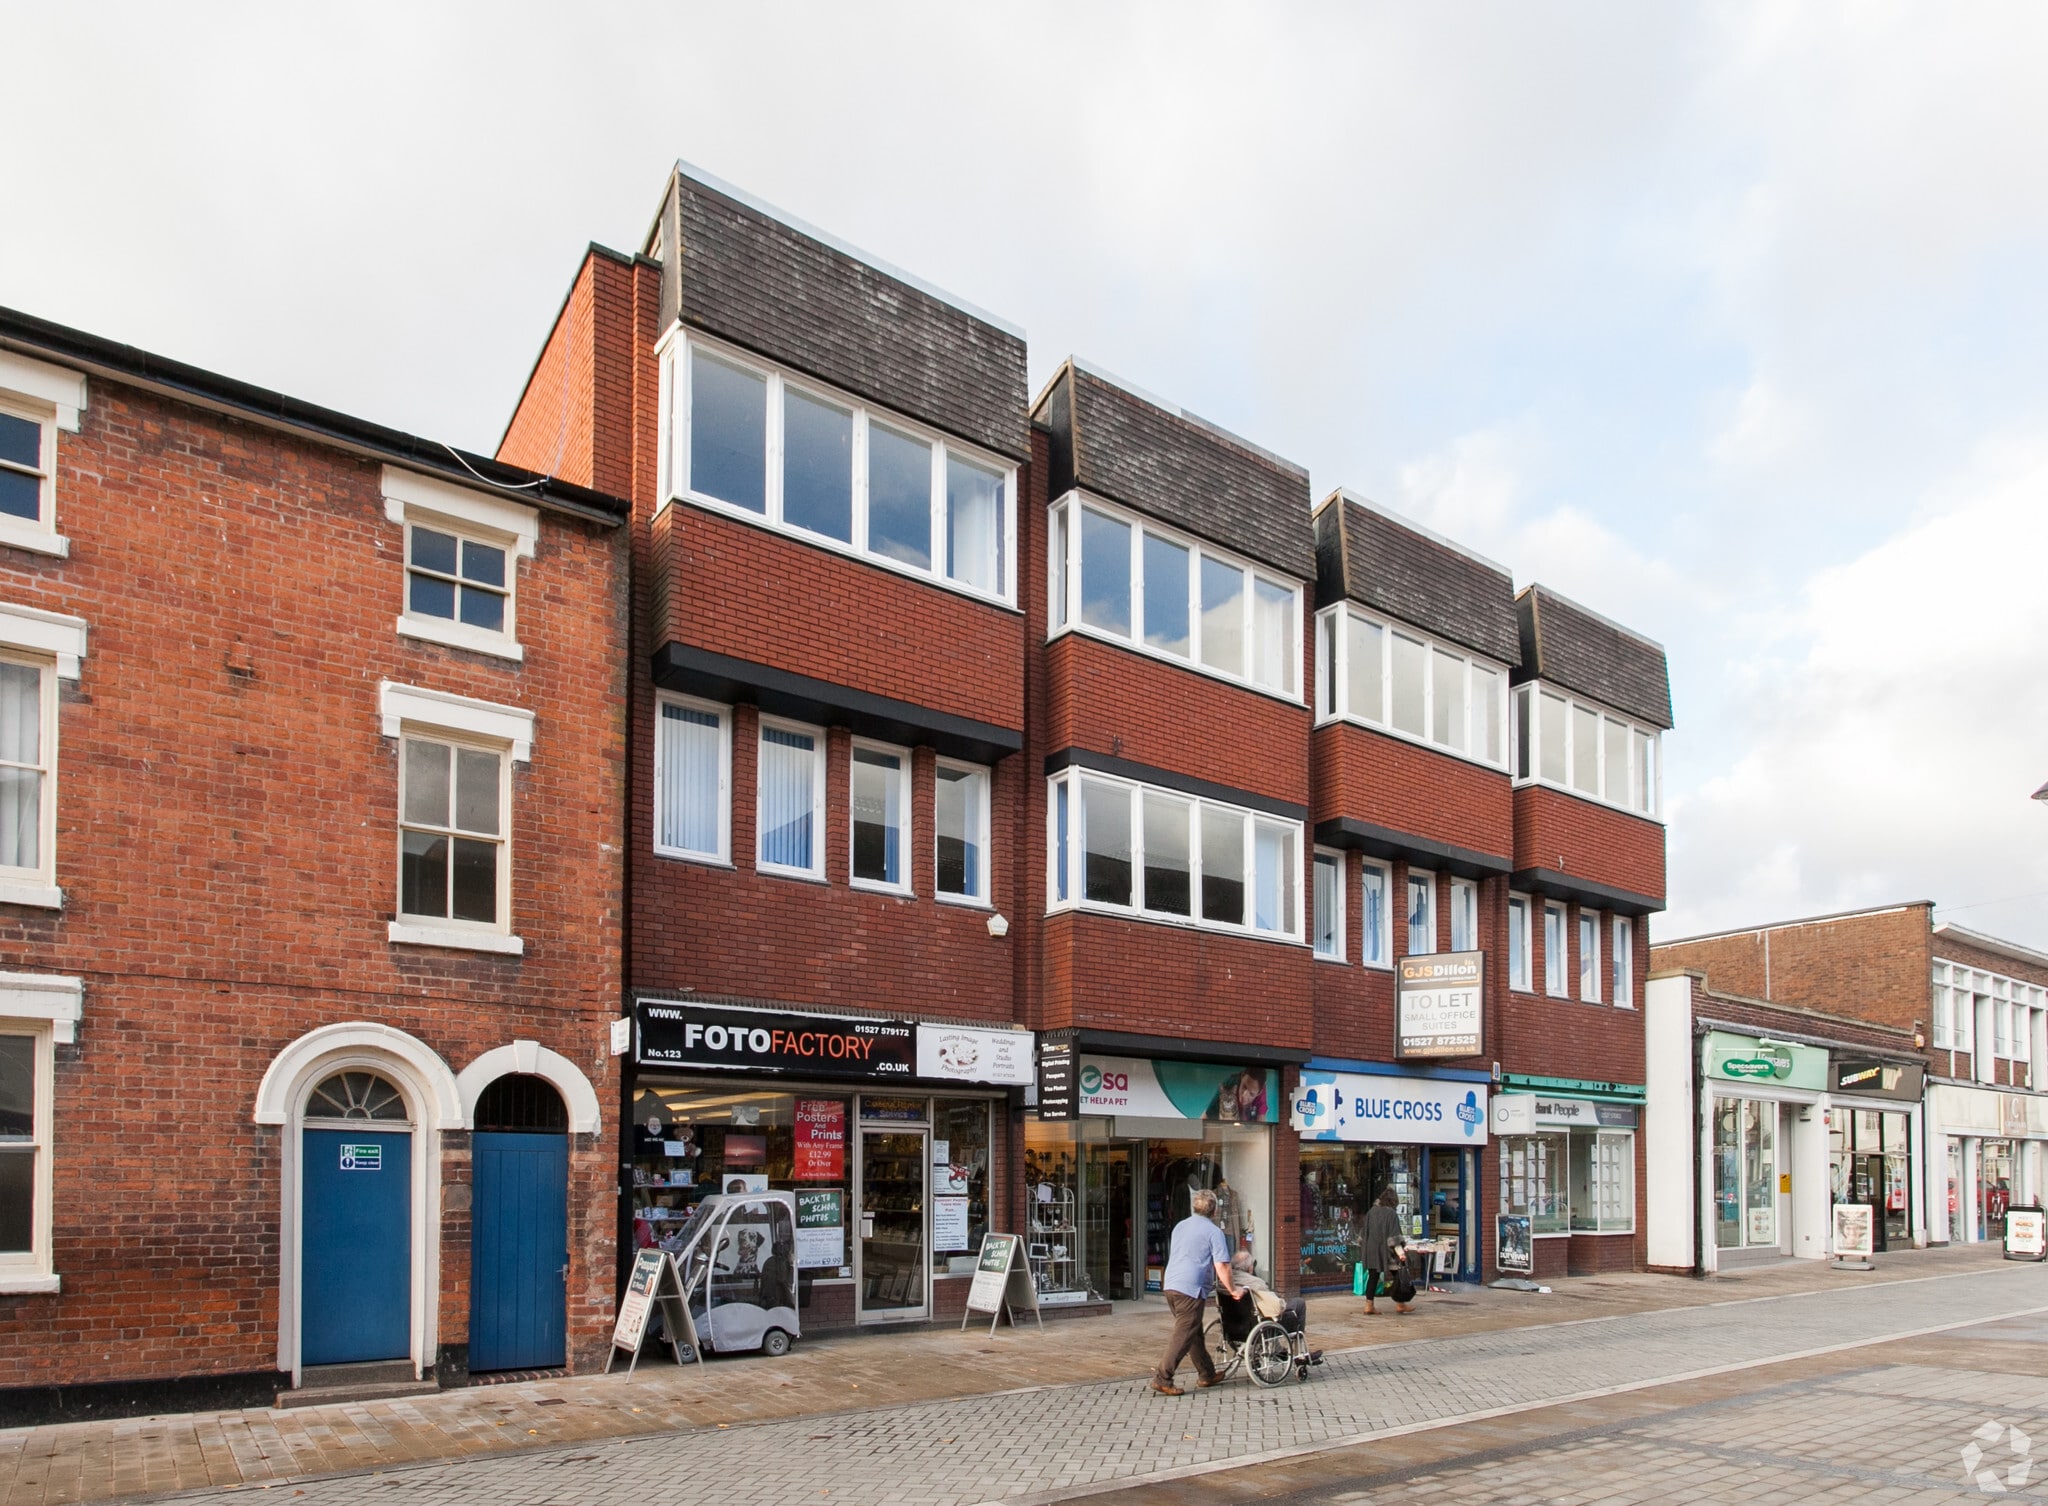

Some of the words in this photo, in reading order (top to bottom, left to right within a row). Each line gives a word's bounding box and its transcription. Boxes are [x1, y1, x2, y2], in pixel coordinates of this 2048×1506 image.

[1404, 965, 1477, 979] GJSDillon
[1408, 995, 1432, 1009] TO
[1438, 993, 1473, 1008] LET
[1404, 1012, 1437, 1022] SMALL
[1440, 1010, 1476, 1020] OFFICE
[855, 1025, 879, 1034] 01527
[881, 1028, 909, 1037] 579172
[1422, 1021, 1457, 1031] SUITES
[961, 1034, 979, 1045] Image
[1403, 1037, 1433, 1047] 01527
[1437, 1035, 1476, 1046] 872525
[648, 1048, 682, 1059] No.123
[876, 1062, 909, 1073] .CO.UK
[941, 1064, 977, 1075] Photography
[1727, 1062, 1769, 1070] Specsavers
[1840, 1067, 1880, 1086] SUBWAY
[1090, 1096, 1108, 1105] HELP
[1115, 1098, 1128, 1106] PET
[800, 1102, 825, 1112] Free
[1356, 1098, 1391, 1118] BLUE
[1393, 1100, 1443, 1122] CROSS
[1554, 1103, 1579, 1118] People
[797, 1112, 838, 1123] Posters
[1459, 1111, 1475, 1121] CROSS
[811, 1130, 842, 1140] Prints
[813, 1142, 824, 1150] Any
[799, 1196, 820, 1206] BACK
[820, 1193, 831, 1202] TO
[812, 1203, 840, 1213] SCHOOL
[800, 1213, 829, 1223] PHOTOS
[985, 1242, 999, 1250] BACK
[1300, 1242, 1316, 1256] will
[1317, 1244, 1347, 1256] survive
[1500, 1252, 1528, 1261] survive!
